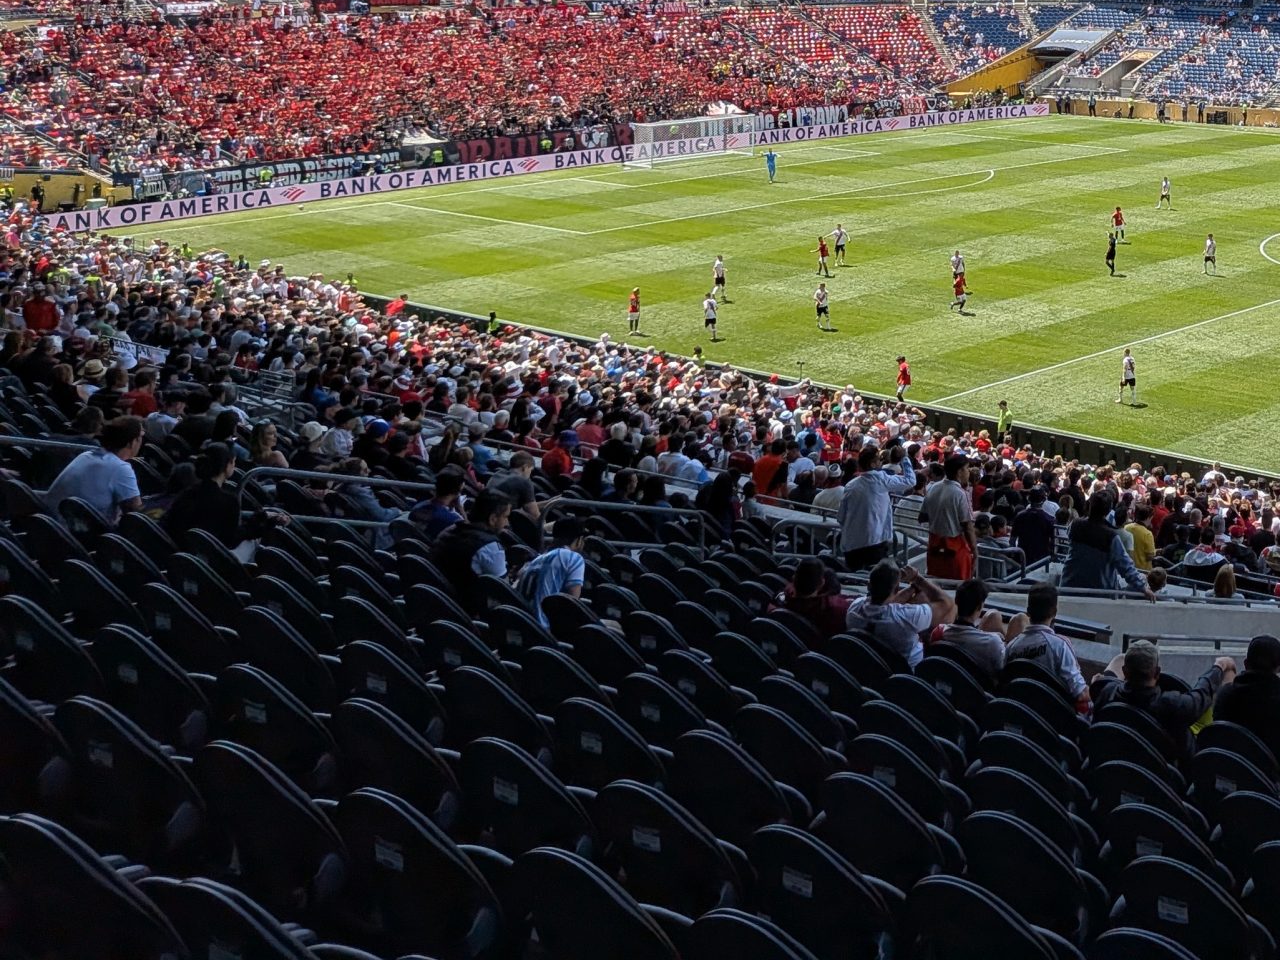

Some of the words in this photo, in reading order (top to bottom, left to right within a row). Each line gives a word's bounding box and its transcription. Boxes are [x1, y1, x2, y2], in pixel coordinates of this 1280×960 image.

[910, 114, 944, 128] BANK
[949, 112, 965, 123] OF
[969, 106, 1027, 121] AMERICA
[752, 131, 790, 145] BANK
[796, 128, 814, 139] OF
[819, 121, 883, 137] AMERICA
[555, 150, 604, 168] BANK
[611, 146, 634, 160] OF
[638, 138, 716, 159] AMERICA
[321, 178, 381, 198] BANK
[389, 172, 415, 189] OF
[422, 161, 514, 185] AMERICA
[45, 209, 110, 231] ANK
[120, 205, 151, 222] OF
[161, 191, 272, 219] AMERICA
